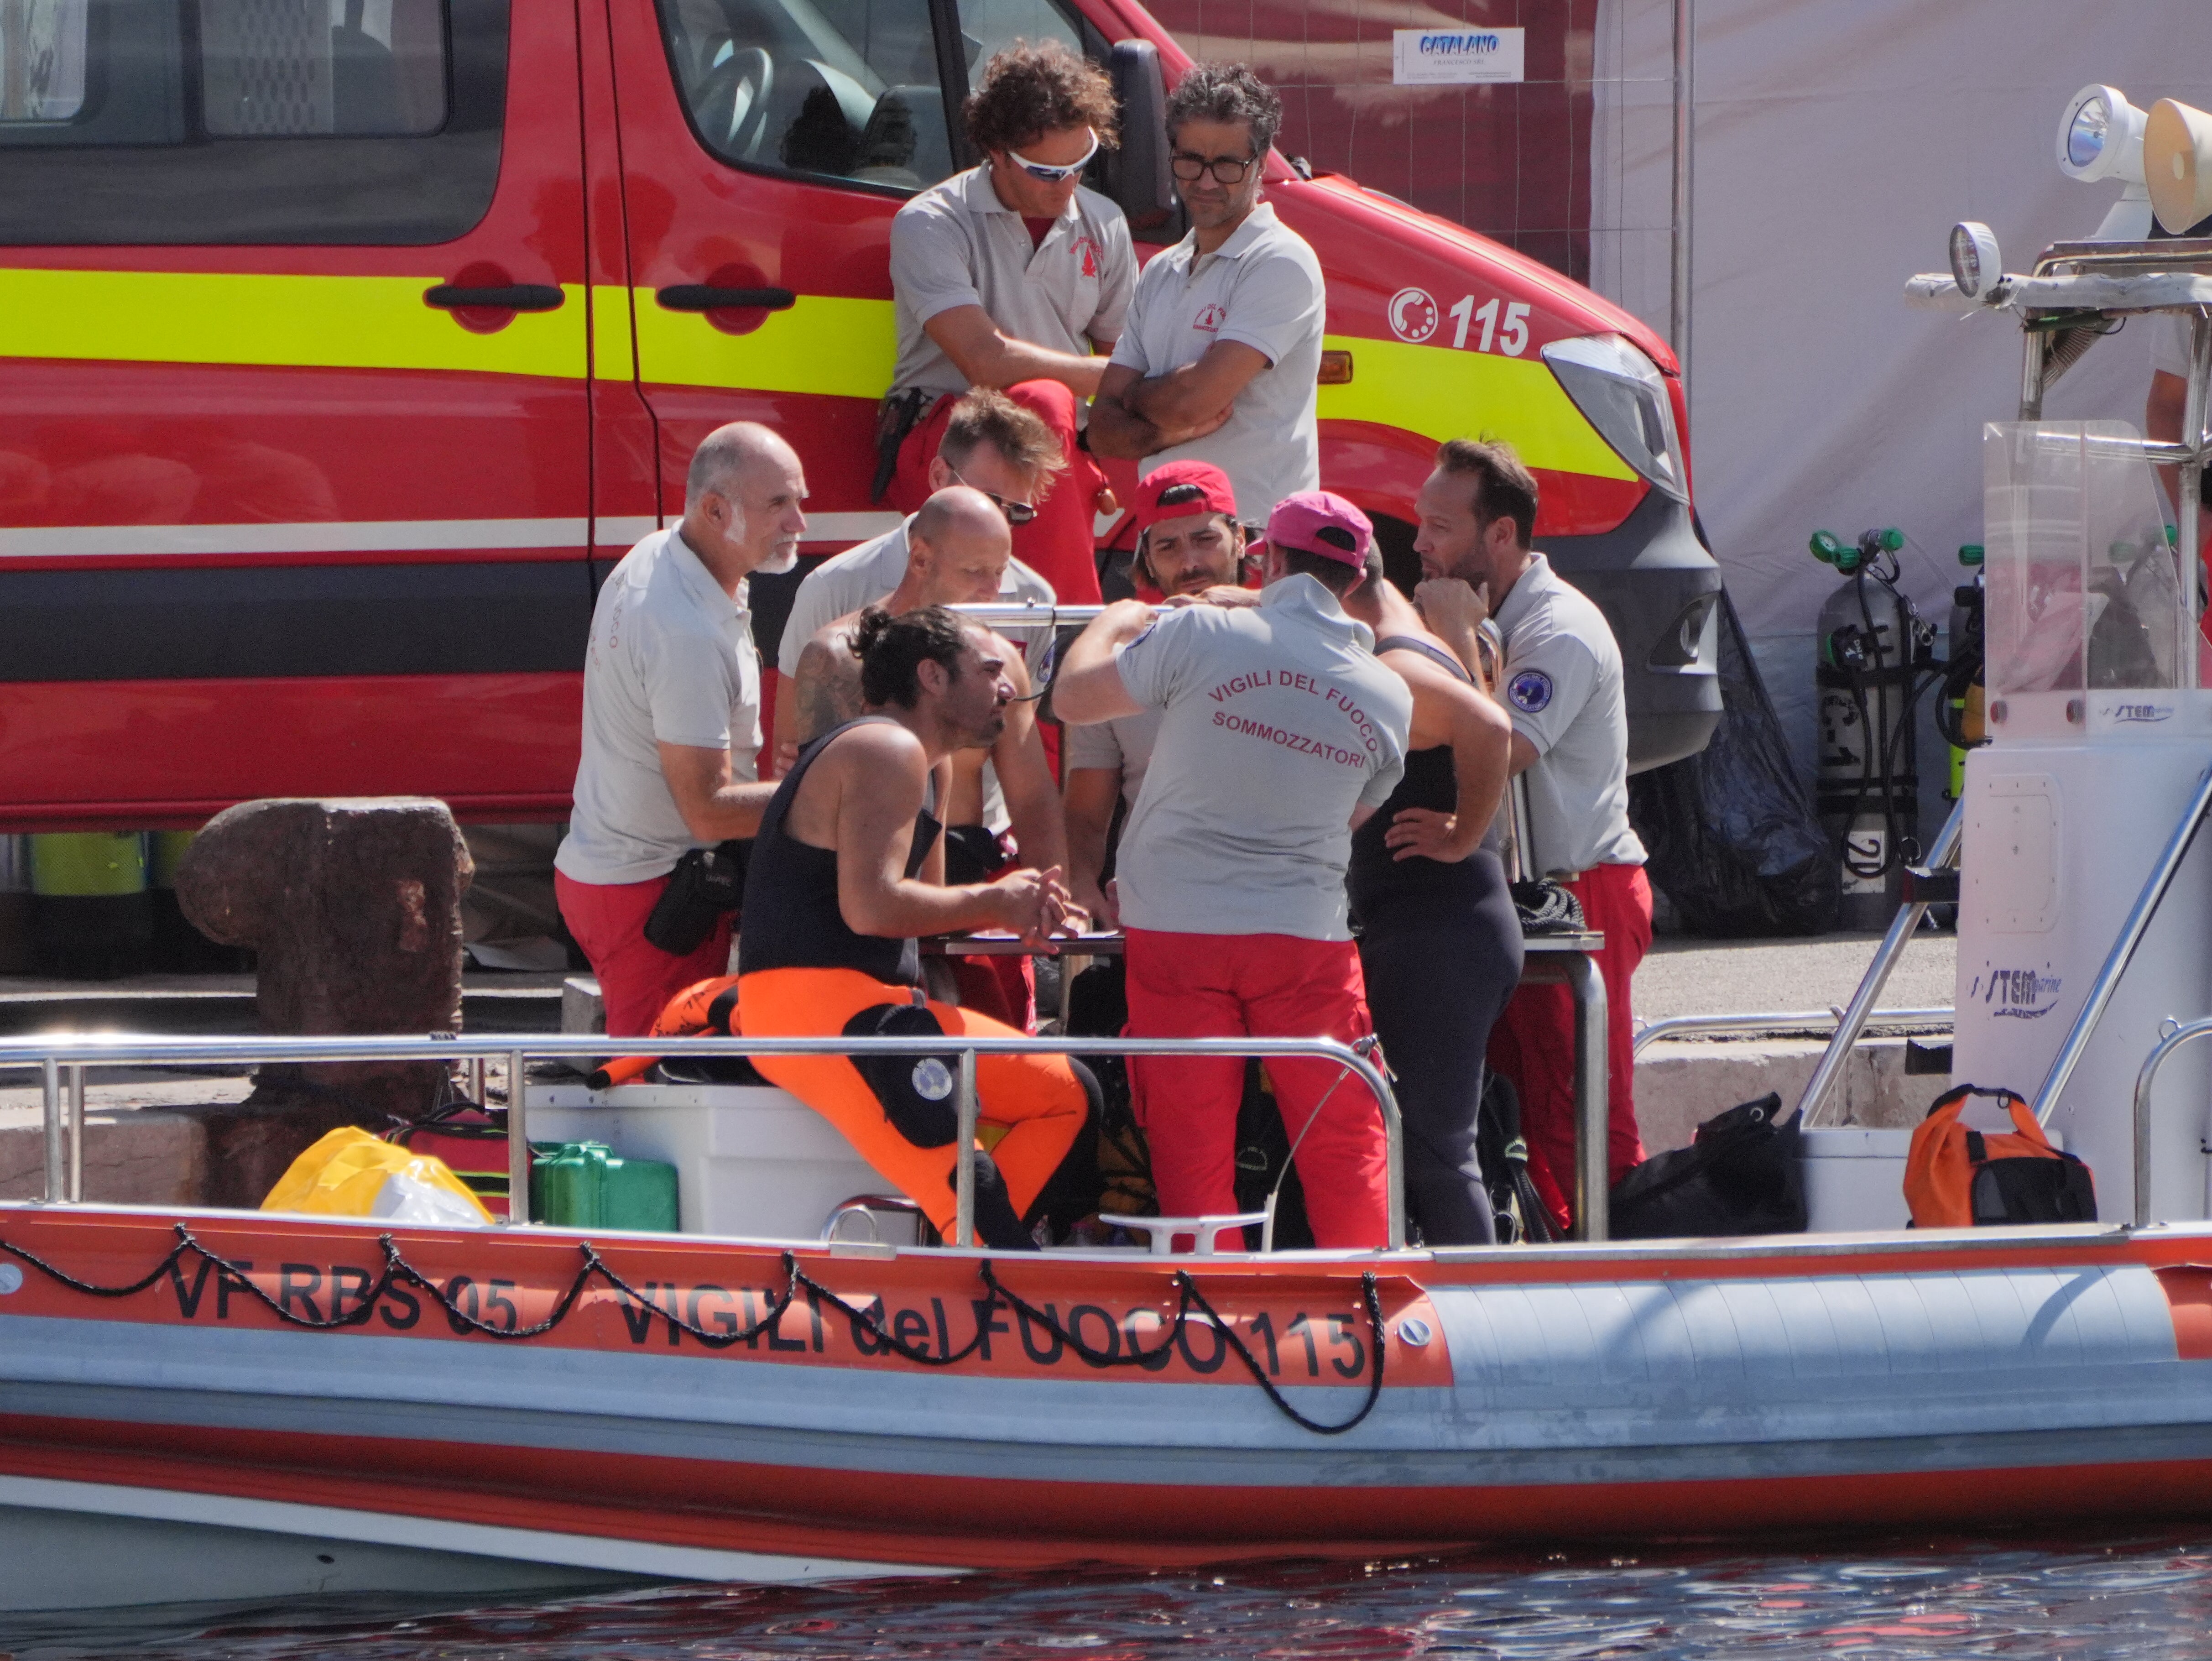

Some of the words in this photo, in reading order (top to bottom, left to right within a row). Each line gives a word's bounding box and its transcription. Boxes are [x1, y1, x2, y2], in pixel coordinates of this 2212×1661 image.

[1419, 35, 1500, 56] CATALANO
[1449, 294, 1531, 356] 115
[1208, 670, 1273, 702] VIGILI
[1279, 670, 1319, 695] DEL
[1325, 688, 1377, 752] FUOCO
[1212, 710, 1366, 768] SOMMOZZATORI
[169, 1258, 254, 1320] VF
[279, 1262, 420, 1330] RBS
[445, 1275, 517, 1336] 05
[614, 1281, 824, 1353] VIGILI
[850, 1293, 951, 1361] del
[970, 1300, 1227, 1374] FUOCO
[1250, 1312, 1366, 1379] 115
